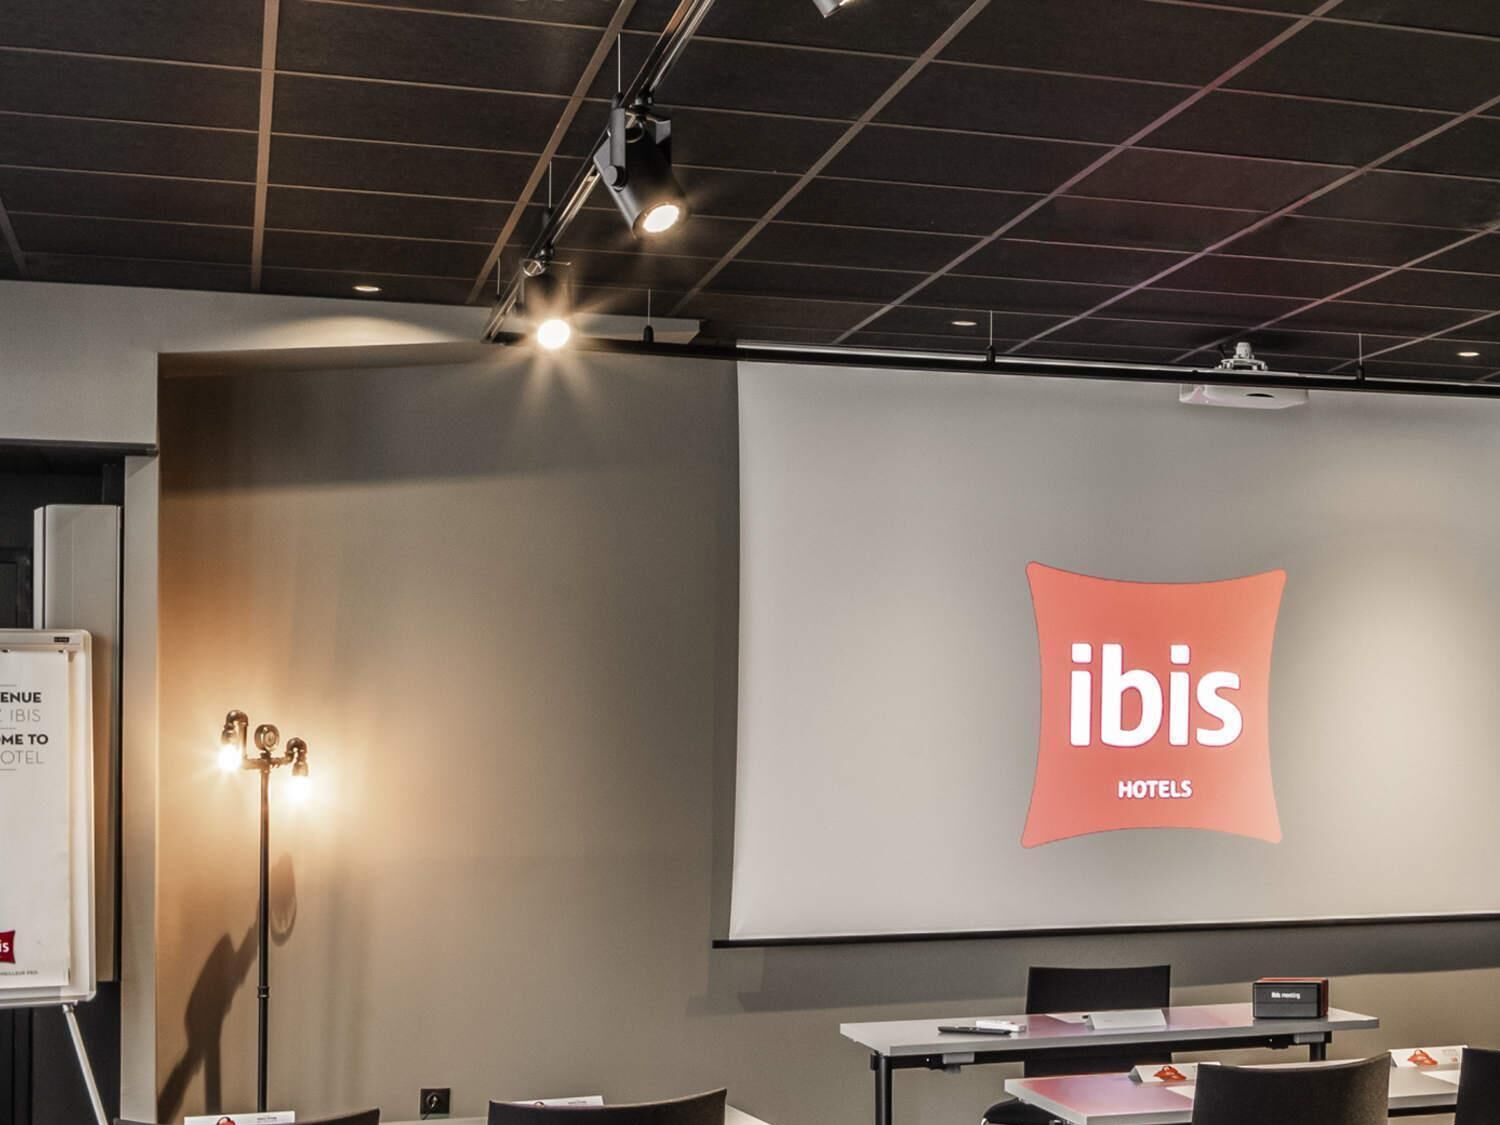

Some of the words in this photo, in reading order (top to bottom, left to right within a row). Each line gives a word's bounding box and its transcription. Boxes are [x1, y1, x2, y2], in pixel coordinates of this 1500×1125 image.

[1070, 643, 1243, 747] ibis
[10, 708, 41, 721] IBIS
[0, 734, 24, 745] ME
[27, 734, 49, 745] TO
[1118, 780, 1192, 799] HOTELS
